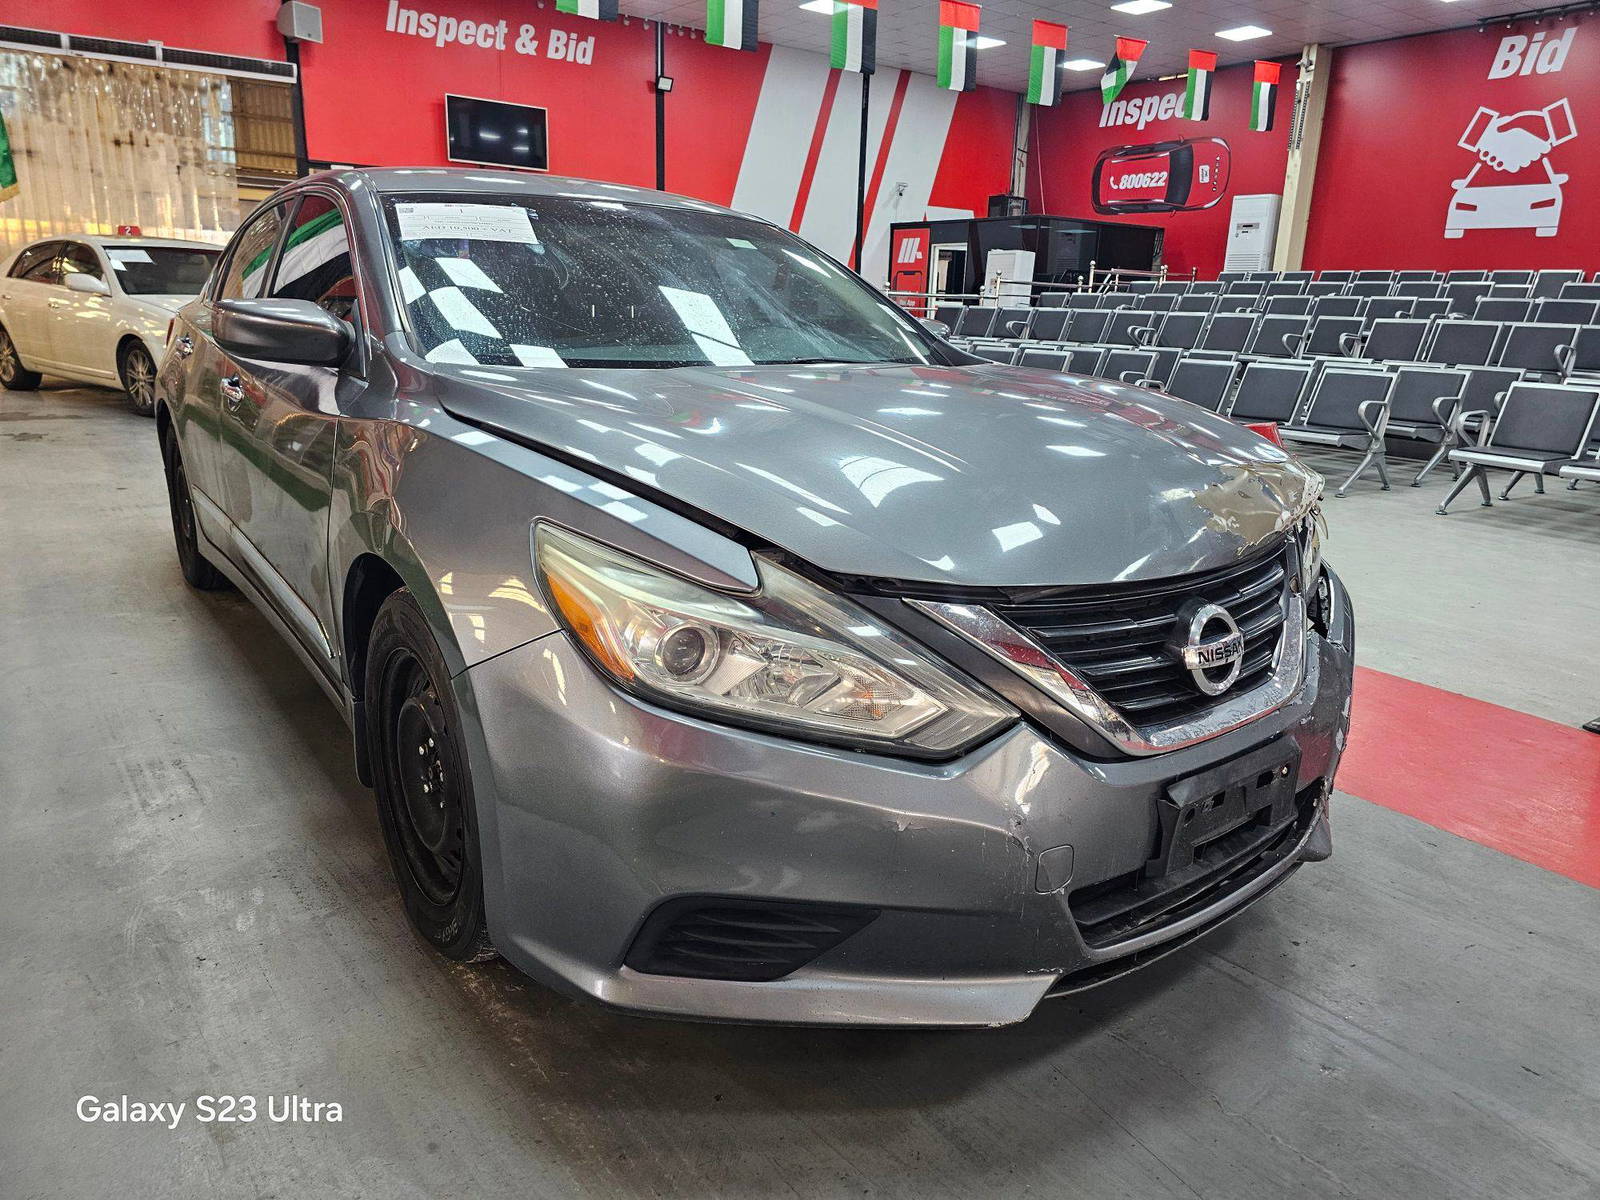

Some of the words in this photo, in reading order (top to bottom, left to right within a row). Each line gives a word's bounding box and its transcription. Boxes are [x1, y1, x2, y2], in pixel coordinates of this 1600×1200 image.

[386, 0, 508, 50] Inspect
[515, 24, 538, 56] &
[547, 29, 595, 65] Bid
[1487, 27, 1579, 80] Bid
[1099, 92, 1187, 130] Inspec
[1119, 172, 1168, 189] 800622
[124, 226, 132, 235] 2
[1198, 641, 1243, 664] NISSAN
